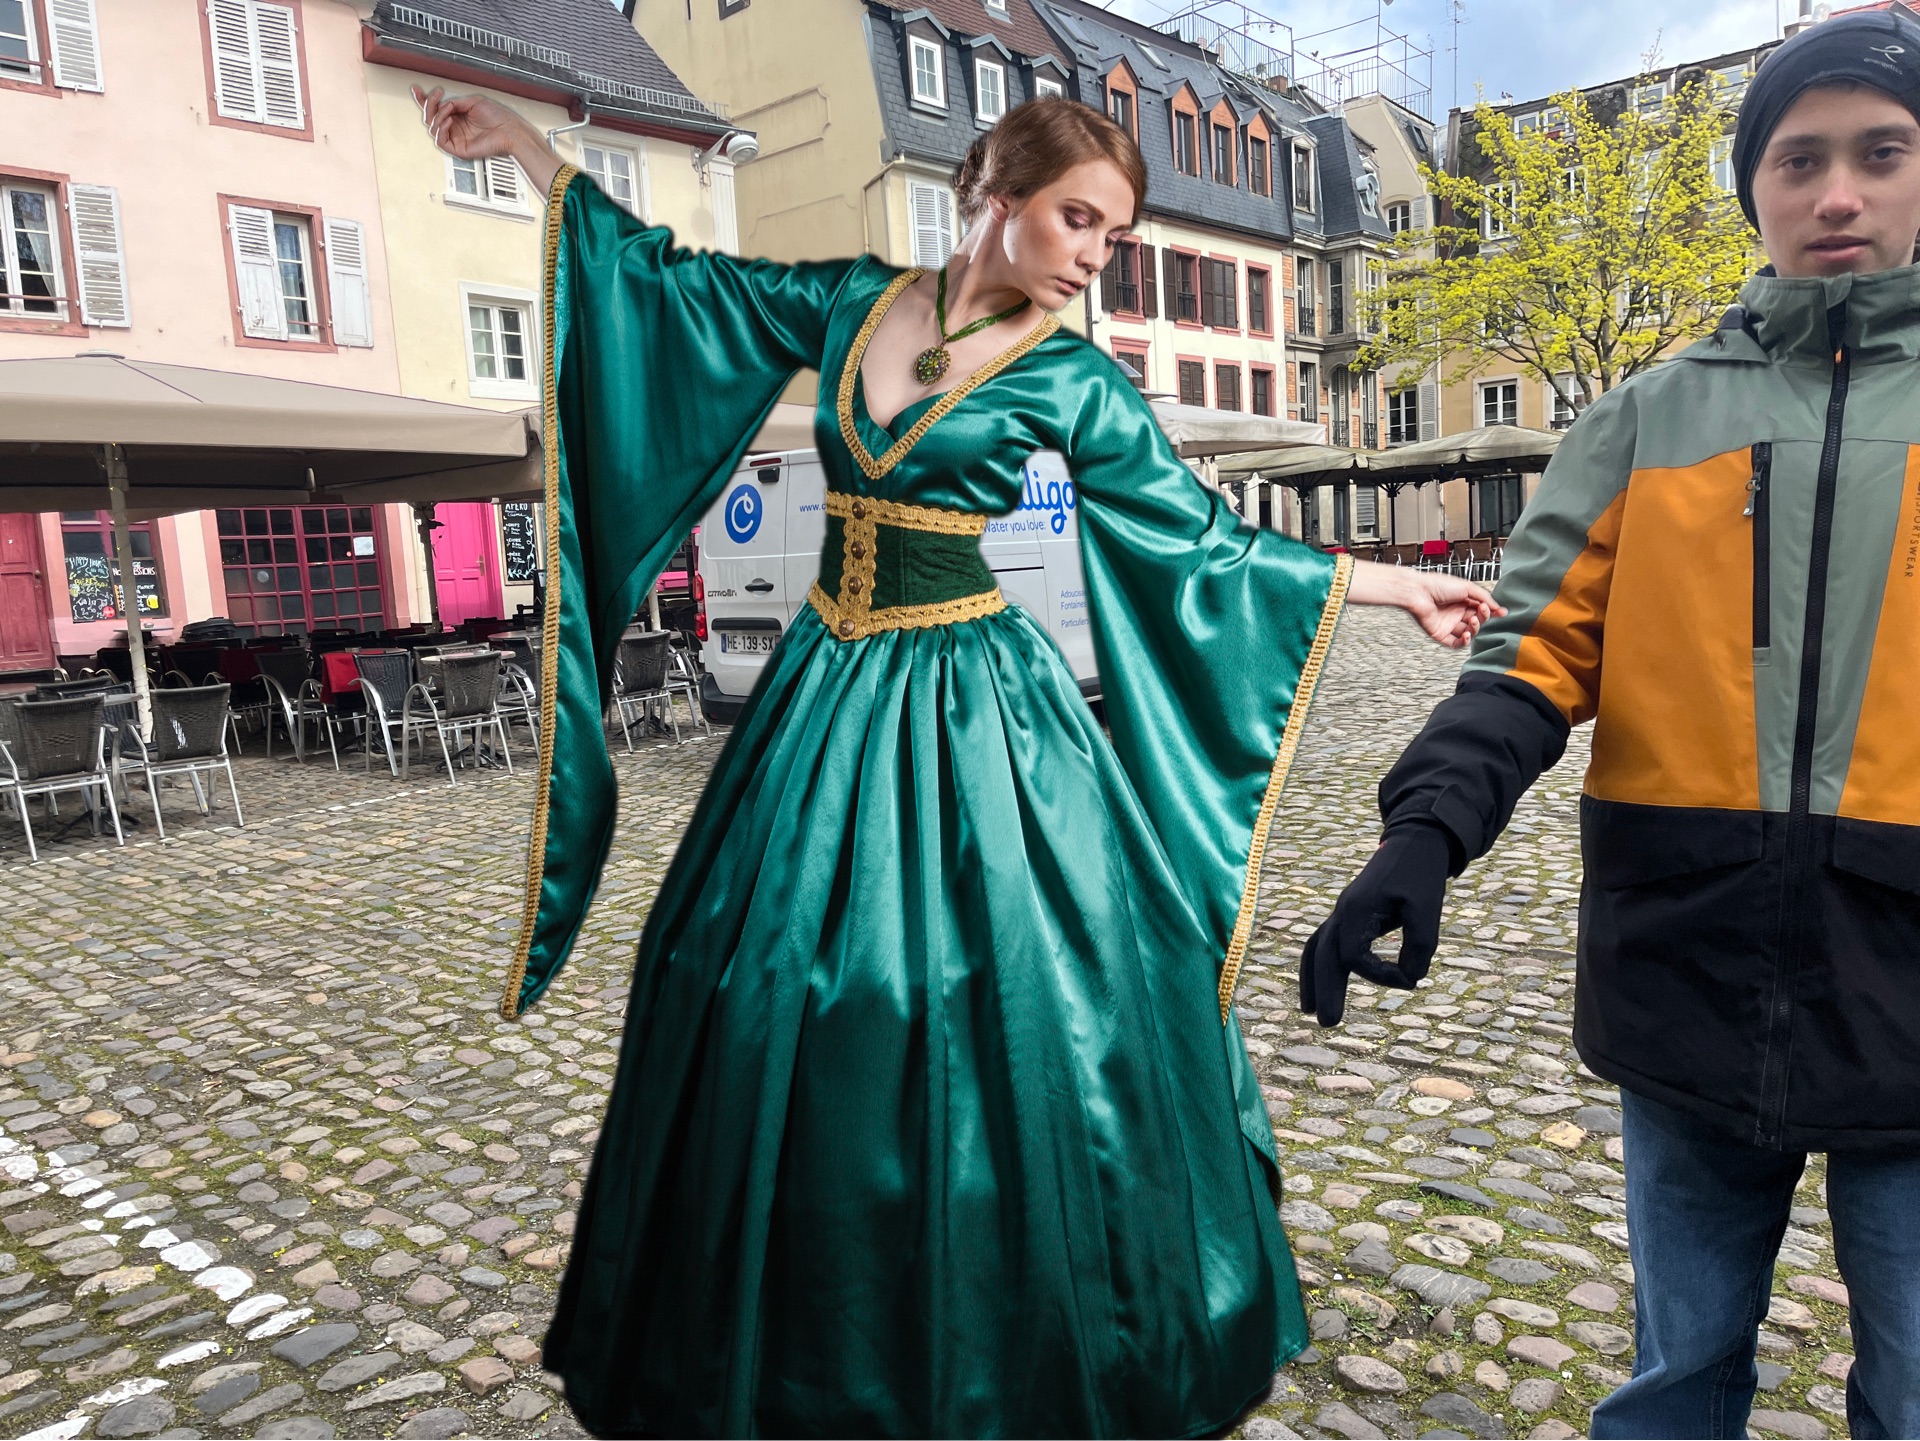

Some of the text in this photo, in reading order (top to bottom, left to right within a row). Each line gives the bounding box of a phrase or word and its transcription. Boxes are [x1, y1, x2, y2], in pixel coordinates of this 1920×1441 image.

[1009, 522, 1026, 535] you
[1060, 618, 1090, 628] Particuliers
[726, 635, 774, 652] HE-139-SX
